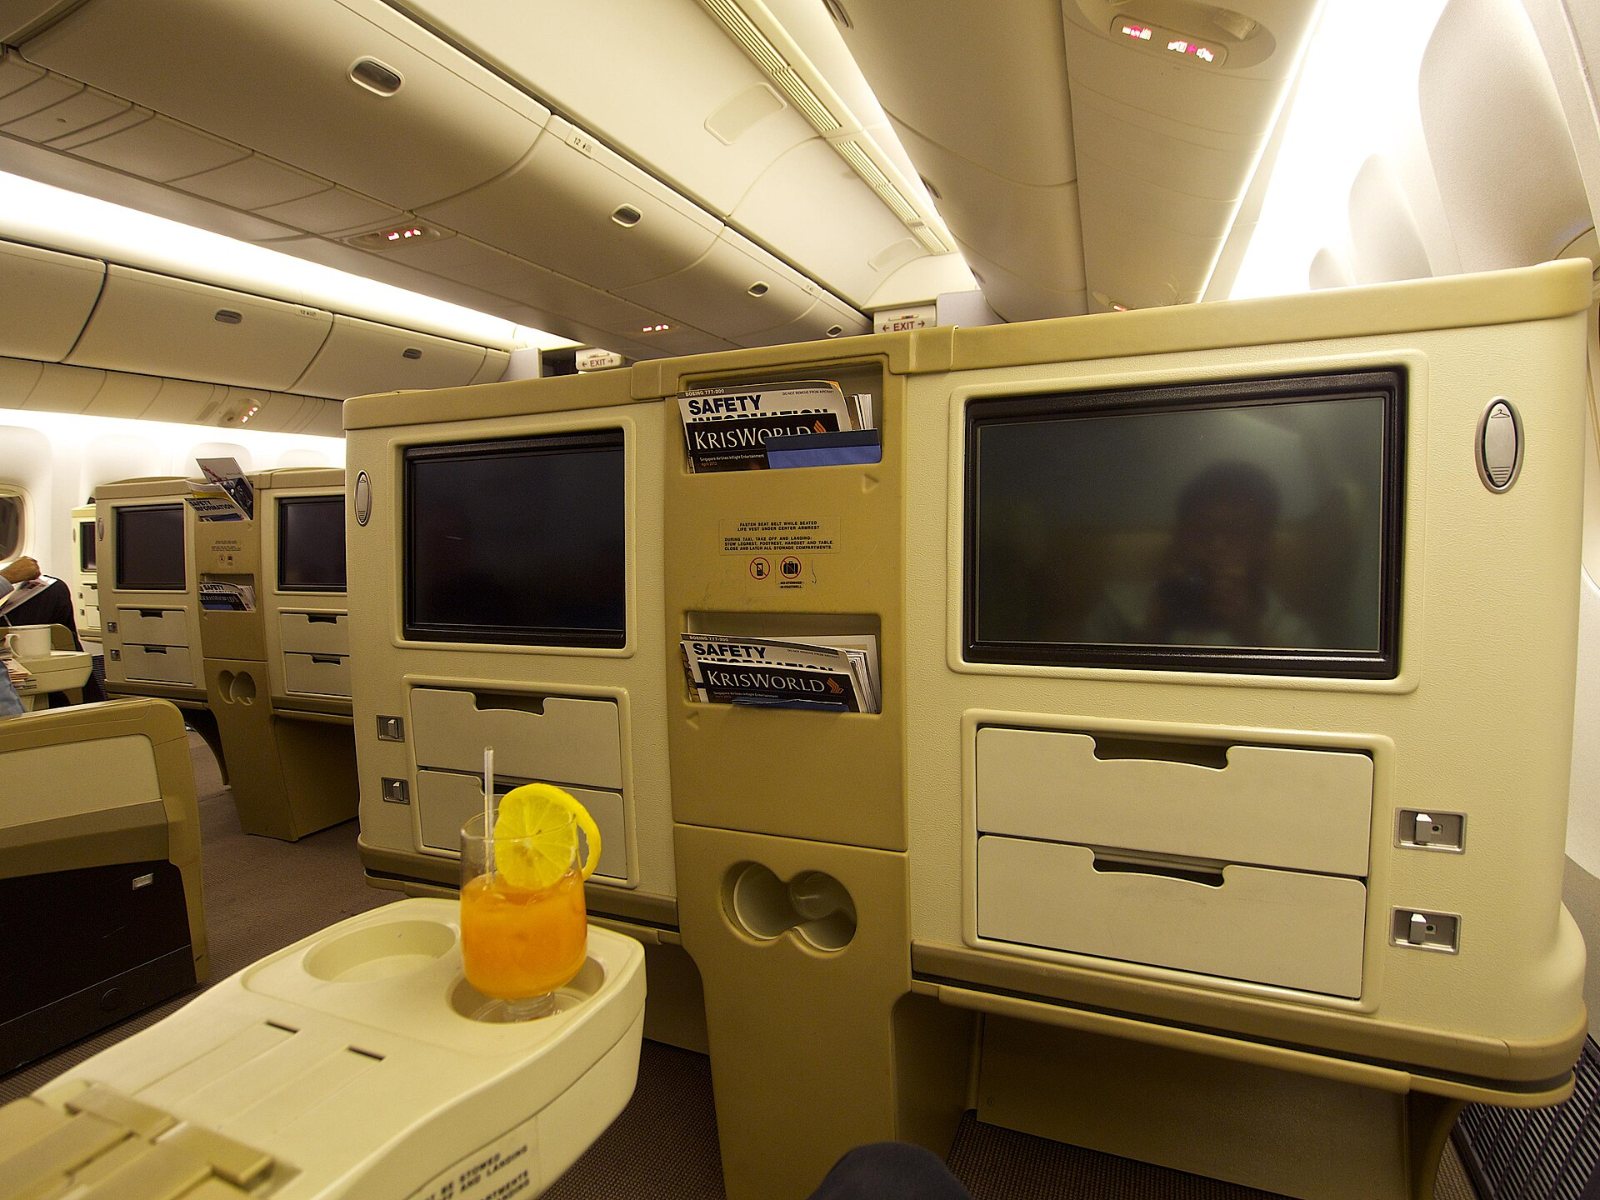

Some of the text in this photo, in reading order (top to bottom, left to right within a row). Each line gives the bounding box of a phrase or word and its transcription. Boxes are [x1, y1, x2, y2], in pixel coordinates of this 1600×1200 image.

[893, 321, 915, 331] EXIT
[590, 358, 606, 367] EXIT
[688, 394, 761, 416] SAFETY
[195, 503, 236, 511] INFORMATION
[692, 643, 766, 659] SAFETY
[707, 670, 825, 692] KRISWORLD
[440, 1152, 501, 1196] BE STOWED
[460, 1144, 528, 1193] AND LANDING
